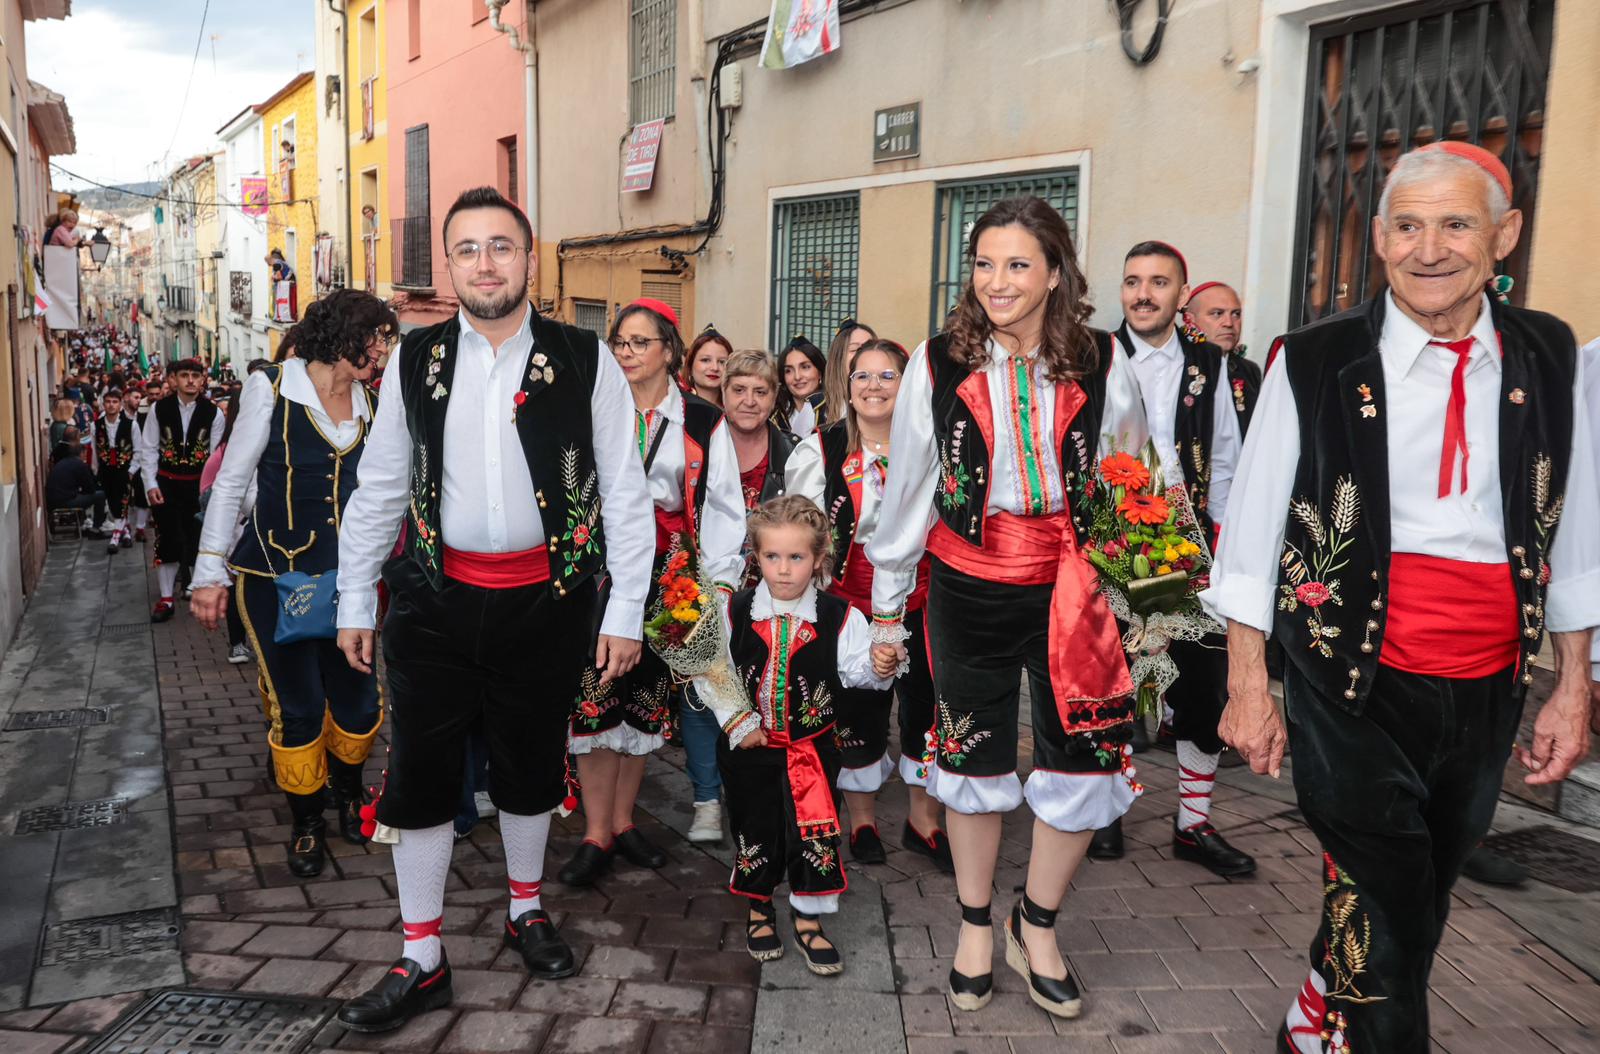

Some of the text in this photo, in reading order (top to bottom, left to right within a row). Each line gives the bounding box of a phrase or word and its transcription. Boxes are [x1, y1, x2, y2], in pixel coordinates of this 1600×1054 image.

[889, 111, 914, 128] CARRER
[639, 125, 660, 142] ZONA
[627, 144, 657, 162] DE TIRO
